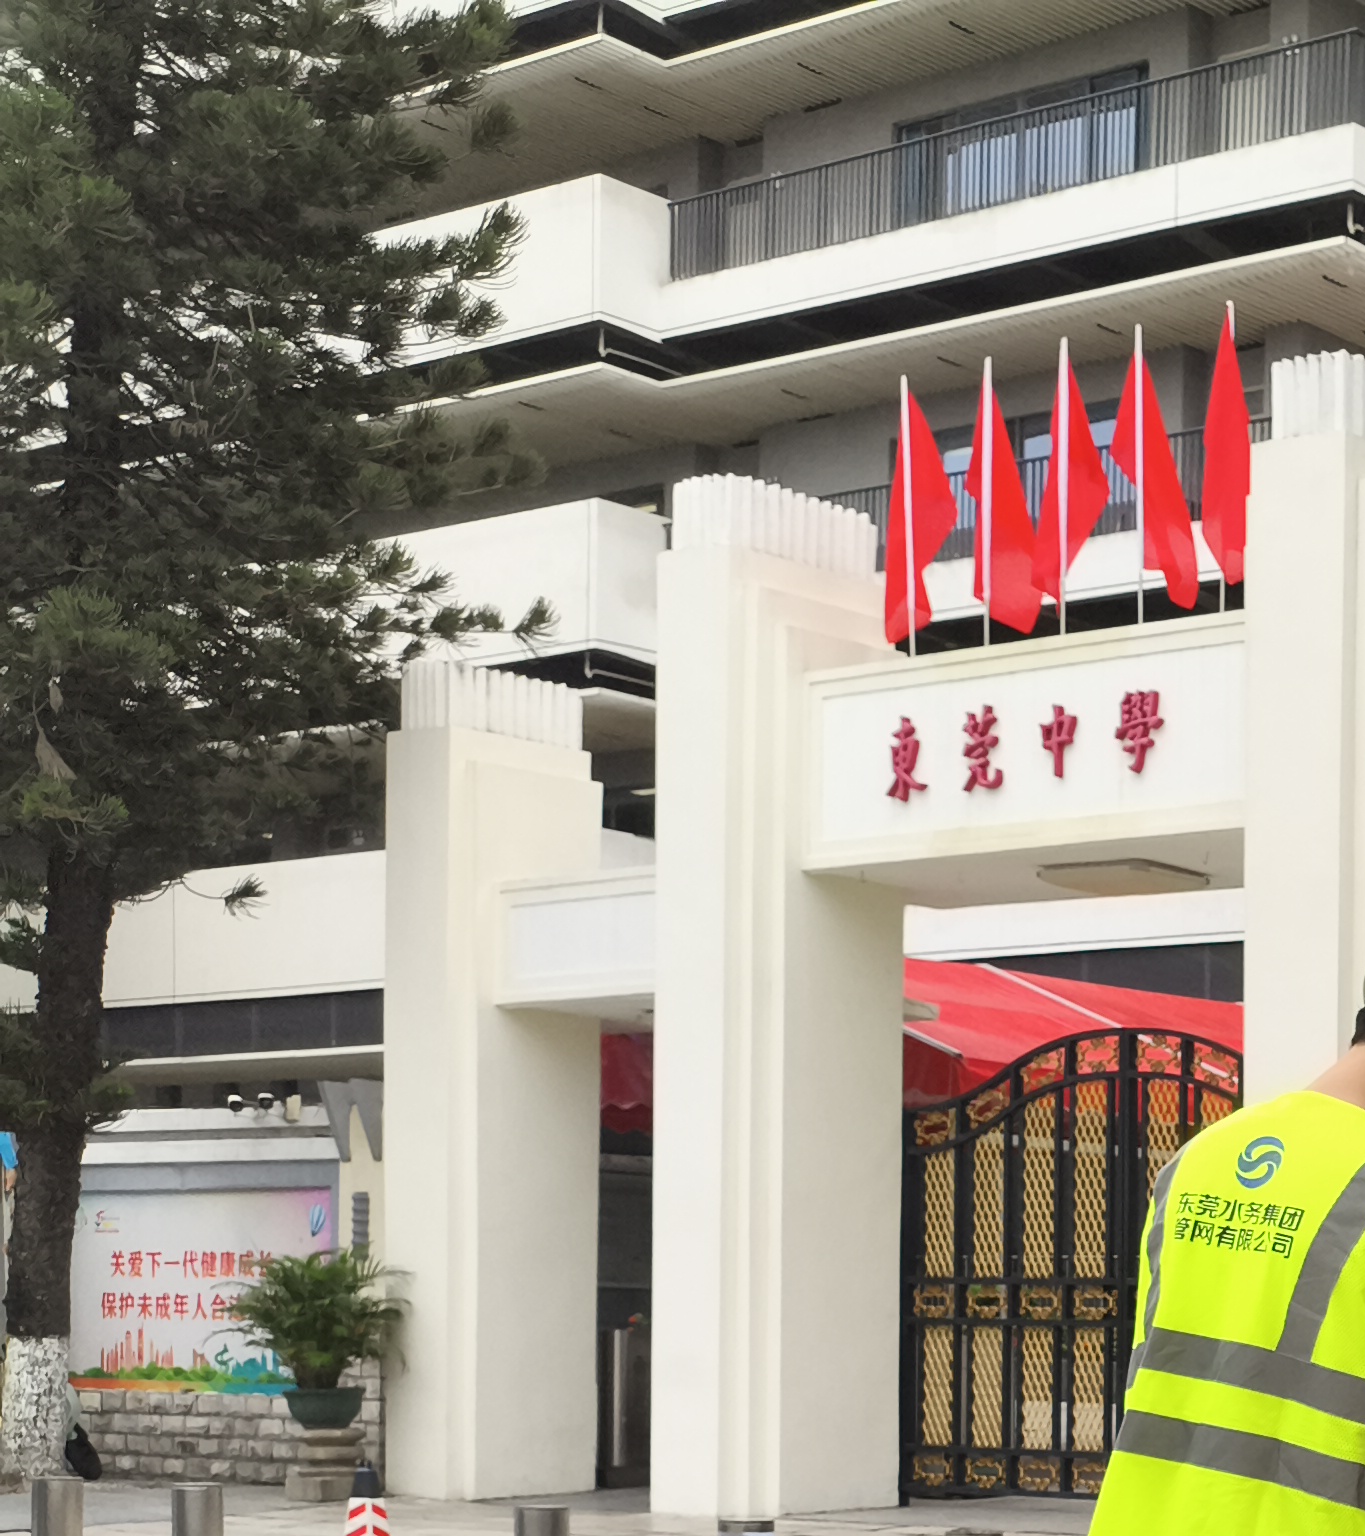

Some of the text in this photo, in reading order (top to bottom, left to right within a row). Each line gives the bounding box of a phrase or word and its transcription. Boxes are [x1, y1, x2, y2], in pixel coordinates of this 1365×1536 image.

[886, 689, 1165, 802] 東莞中學
[1176, 1192, 1305, 1231] 东莞水务集团
[1174, 1217, 1295, 1259] 管网有限公司
